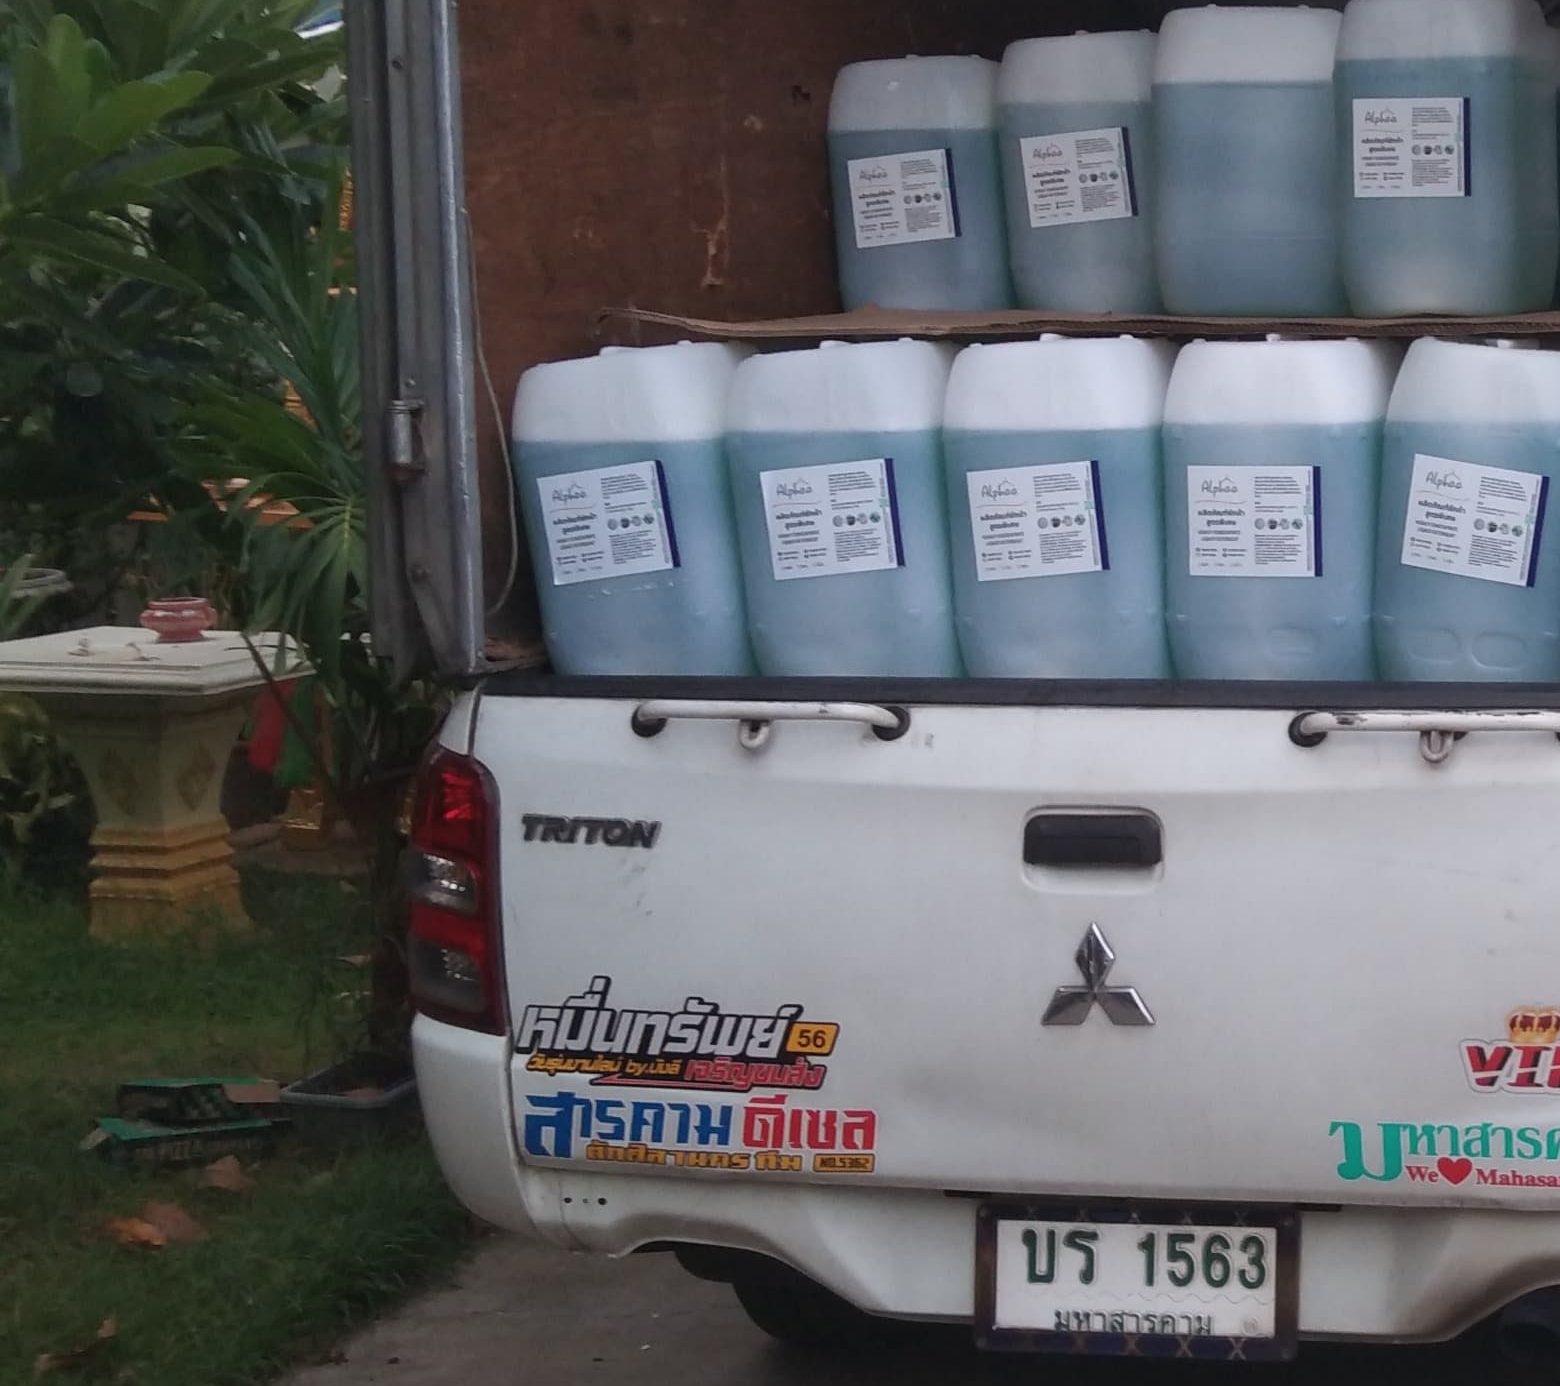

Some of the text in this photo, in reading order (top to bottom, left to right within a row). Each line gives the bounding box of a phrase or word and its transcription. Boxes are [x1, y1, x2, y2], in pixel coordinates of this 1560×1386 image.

[521, 813, 661, 849] TRITON
[514, 975, 827, 1059] หมื่นทรัพย์ 56
[1406, 1165, 1440, 1185] We
[1021, 1227, 1267, 1290] บร 1563
